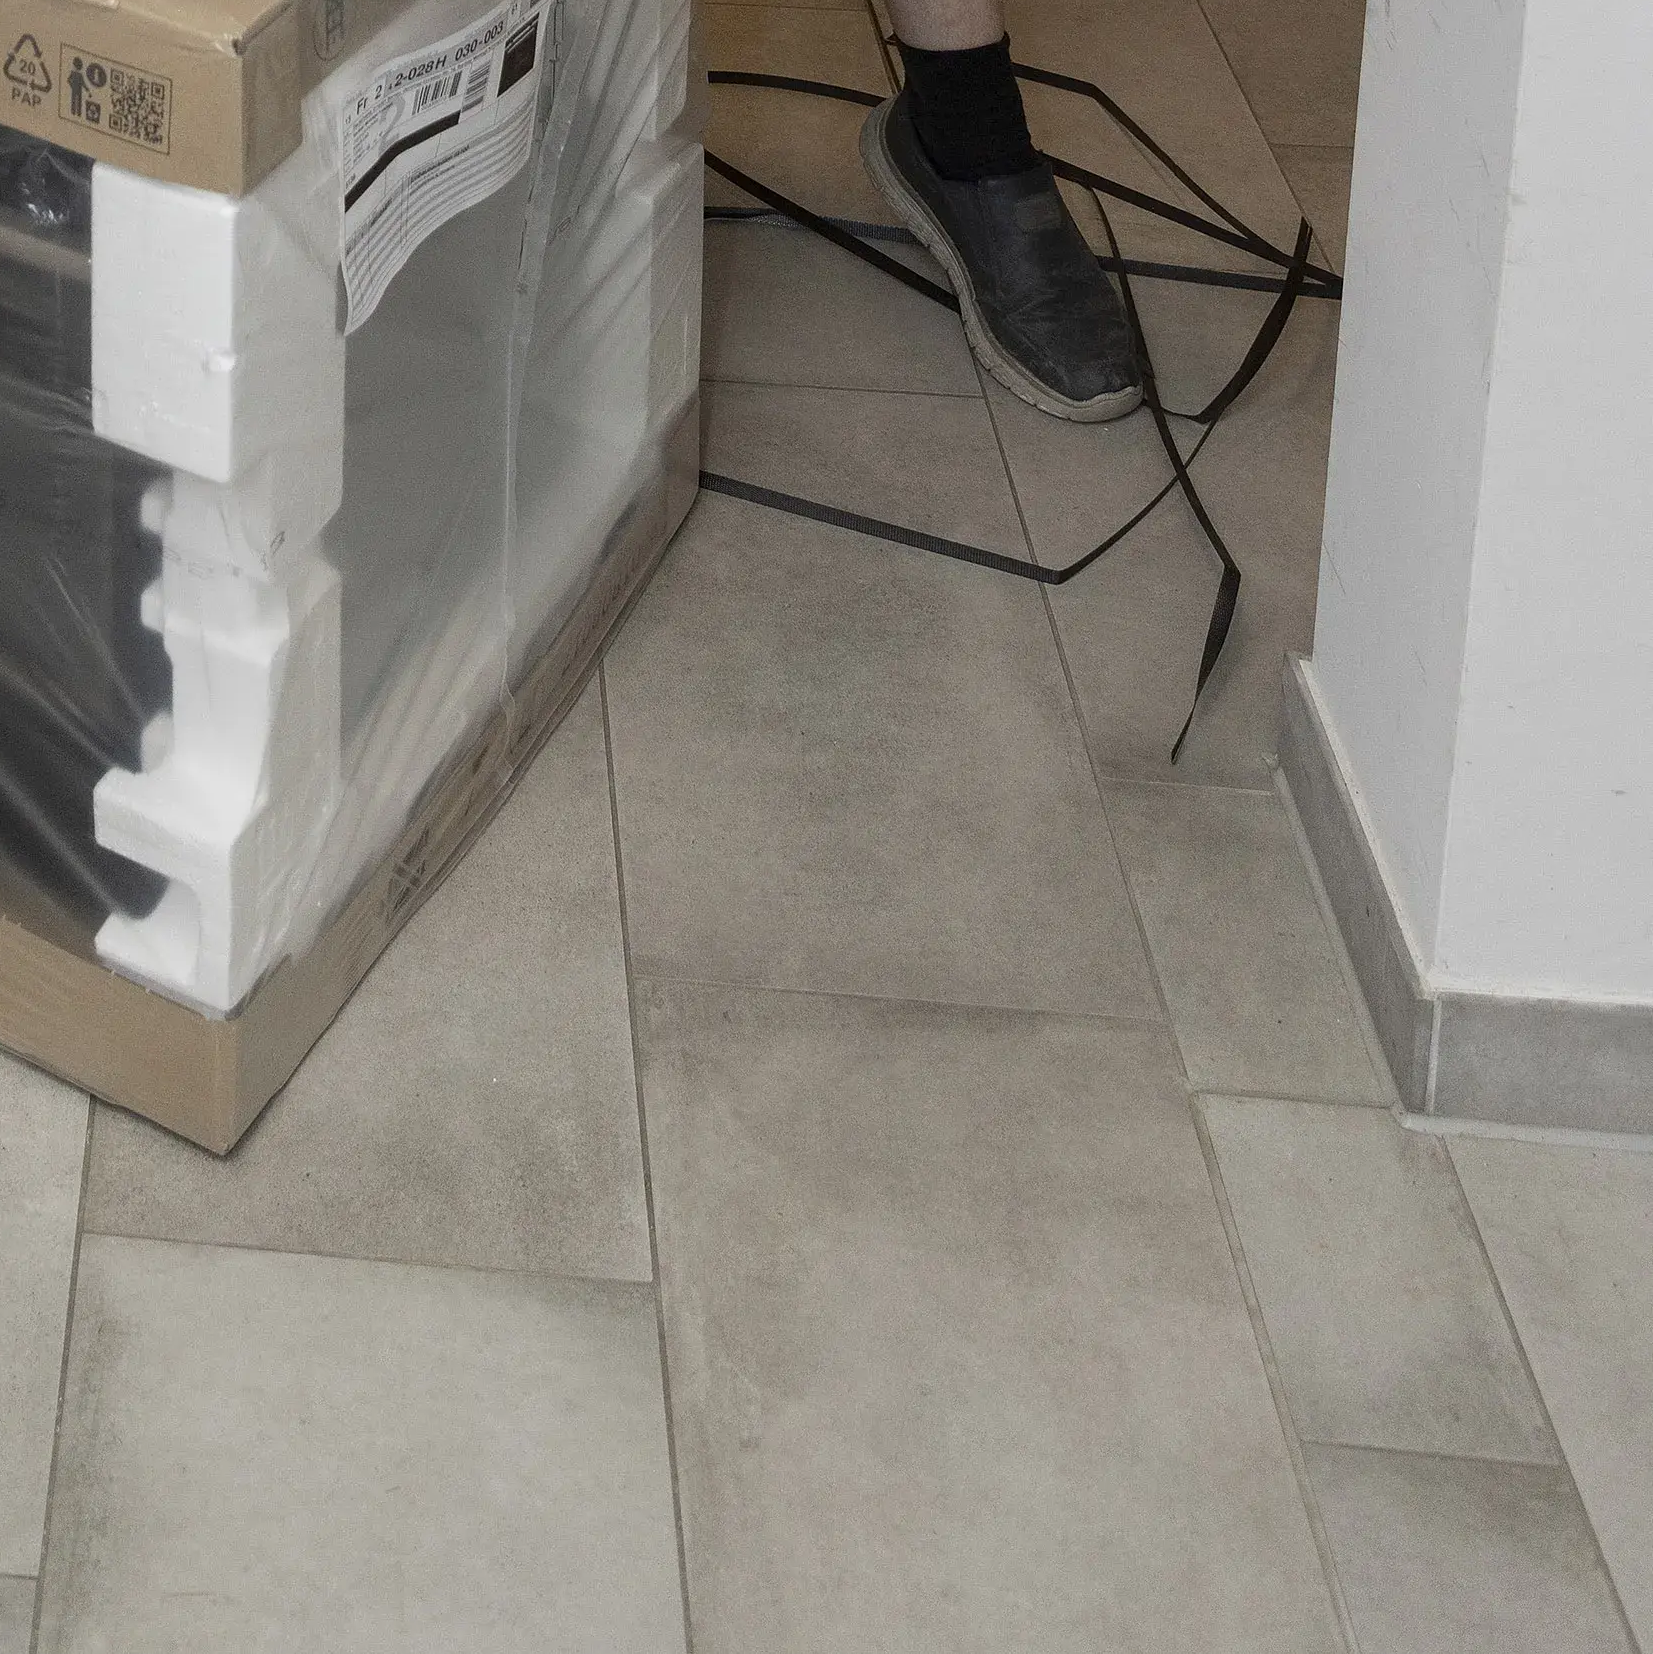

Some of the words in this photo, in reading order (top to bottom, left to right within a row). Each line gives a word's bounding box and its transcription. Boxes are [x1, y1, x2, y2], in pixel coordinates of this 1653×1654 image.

[455, 21, 504, 62] 030-003
[19, 59, 36, 76] 20
[11, 87, 43, 107] PAP
[374, 84, 382, 100] 2
